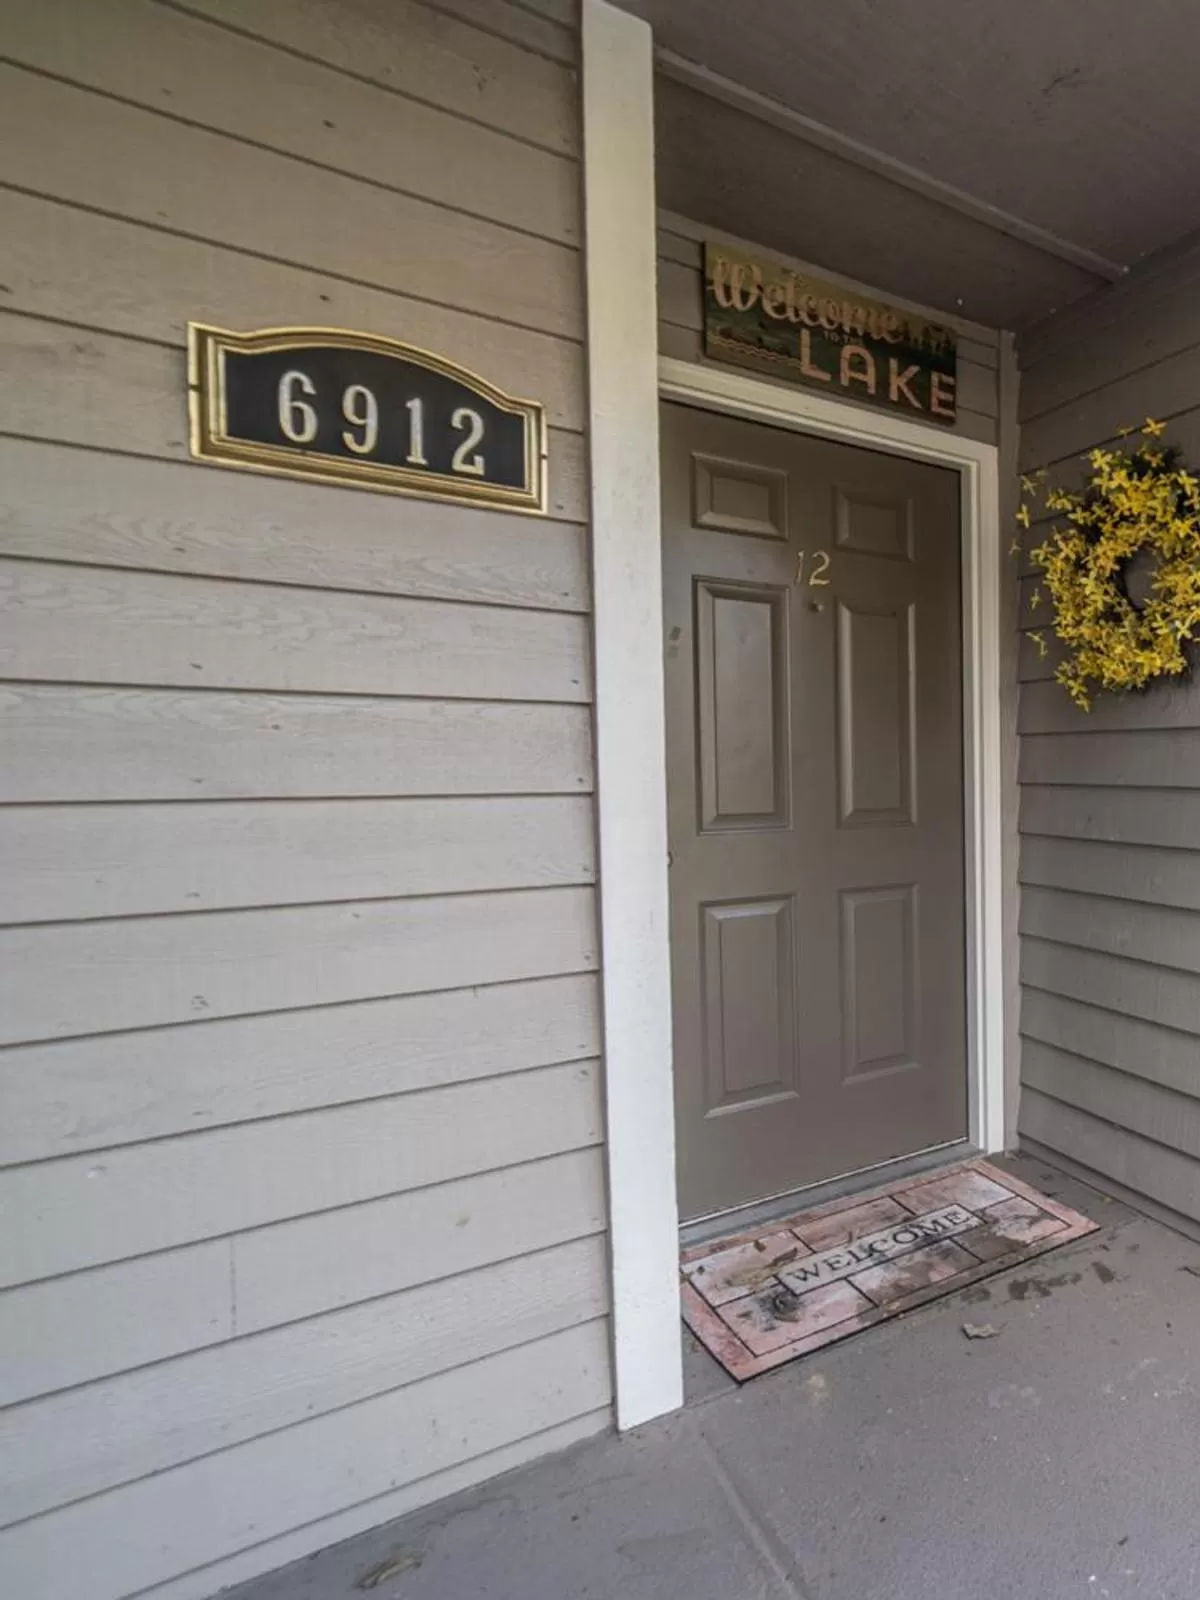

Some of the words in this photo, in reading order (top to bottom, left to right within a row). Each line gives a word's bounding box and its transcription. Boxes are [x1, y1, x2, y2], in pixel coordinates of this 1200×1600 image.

[711, 256, 902, 344] Welcome
[800, 328, 955, 418] LAKE
[278, 370, 485, 476] 6912
[797, 550, 830, 586] 12
[787, 1211, 969, 1283] WELCOME
